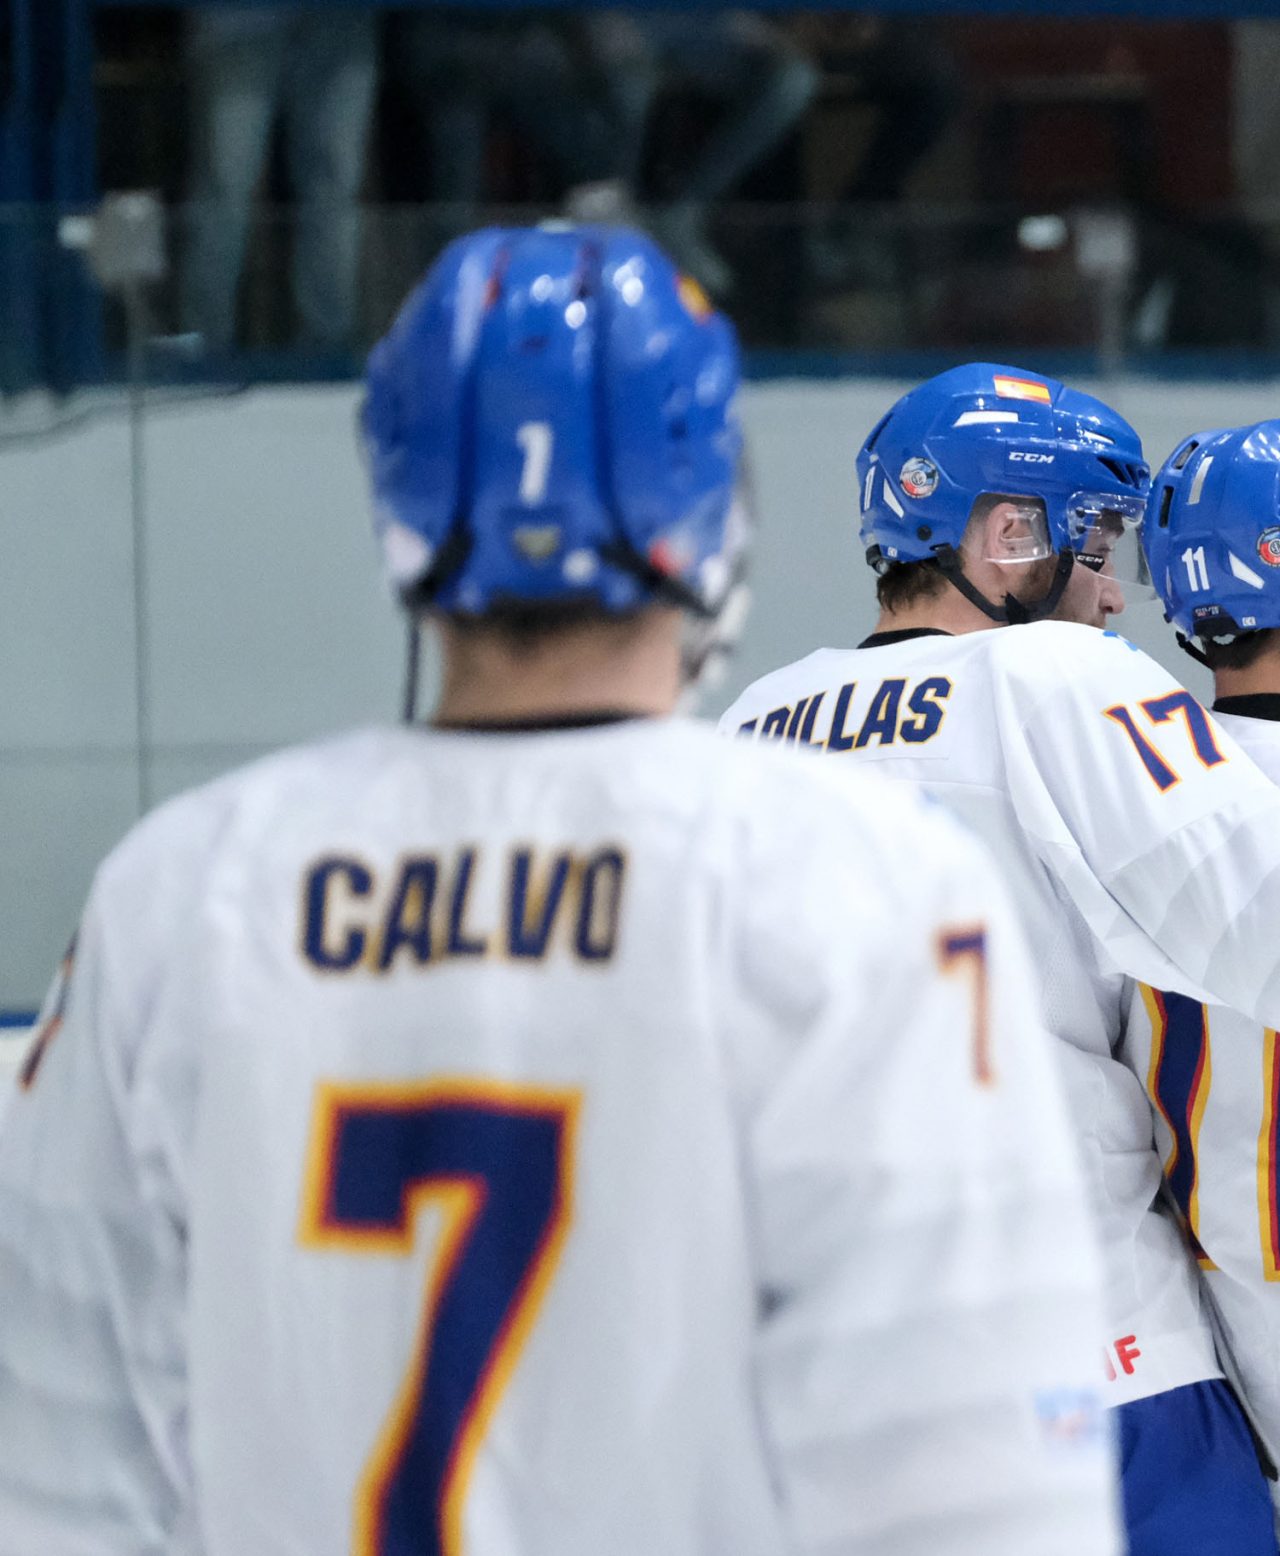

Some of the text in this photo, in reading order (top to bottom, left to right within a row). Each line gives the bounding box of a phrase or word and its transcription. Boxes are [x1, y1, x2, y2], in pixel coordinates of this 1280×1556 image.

[1009, 451, 1055, 464] CCM
[1181, 546, 1211, 592] 11
[1101, 688, 1230, 794] 17
[302, 842, 628, 975] CALVO
[933, 918, 996, 1087] 7
[296, 1076, 585, 1556] 7
